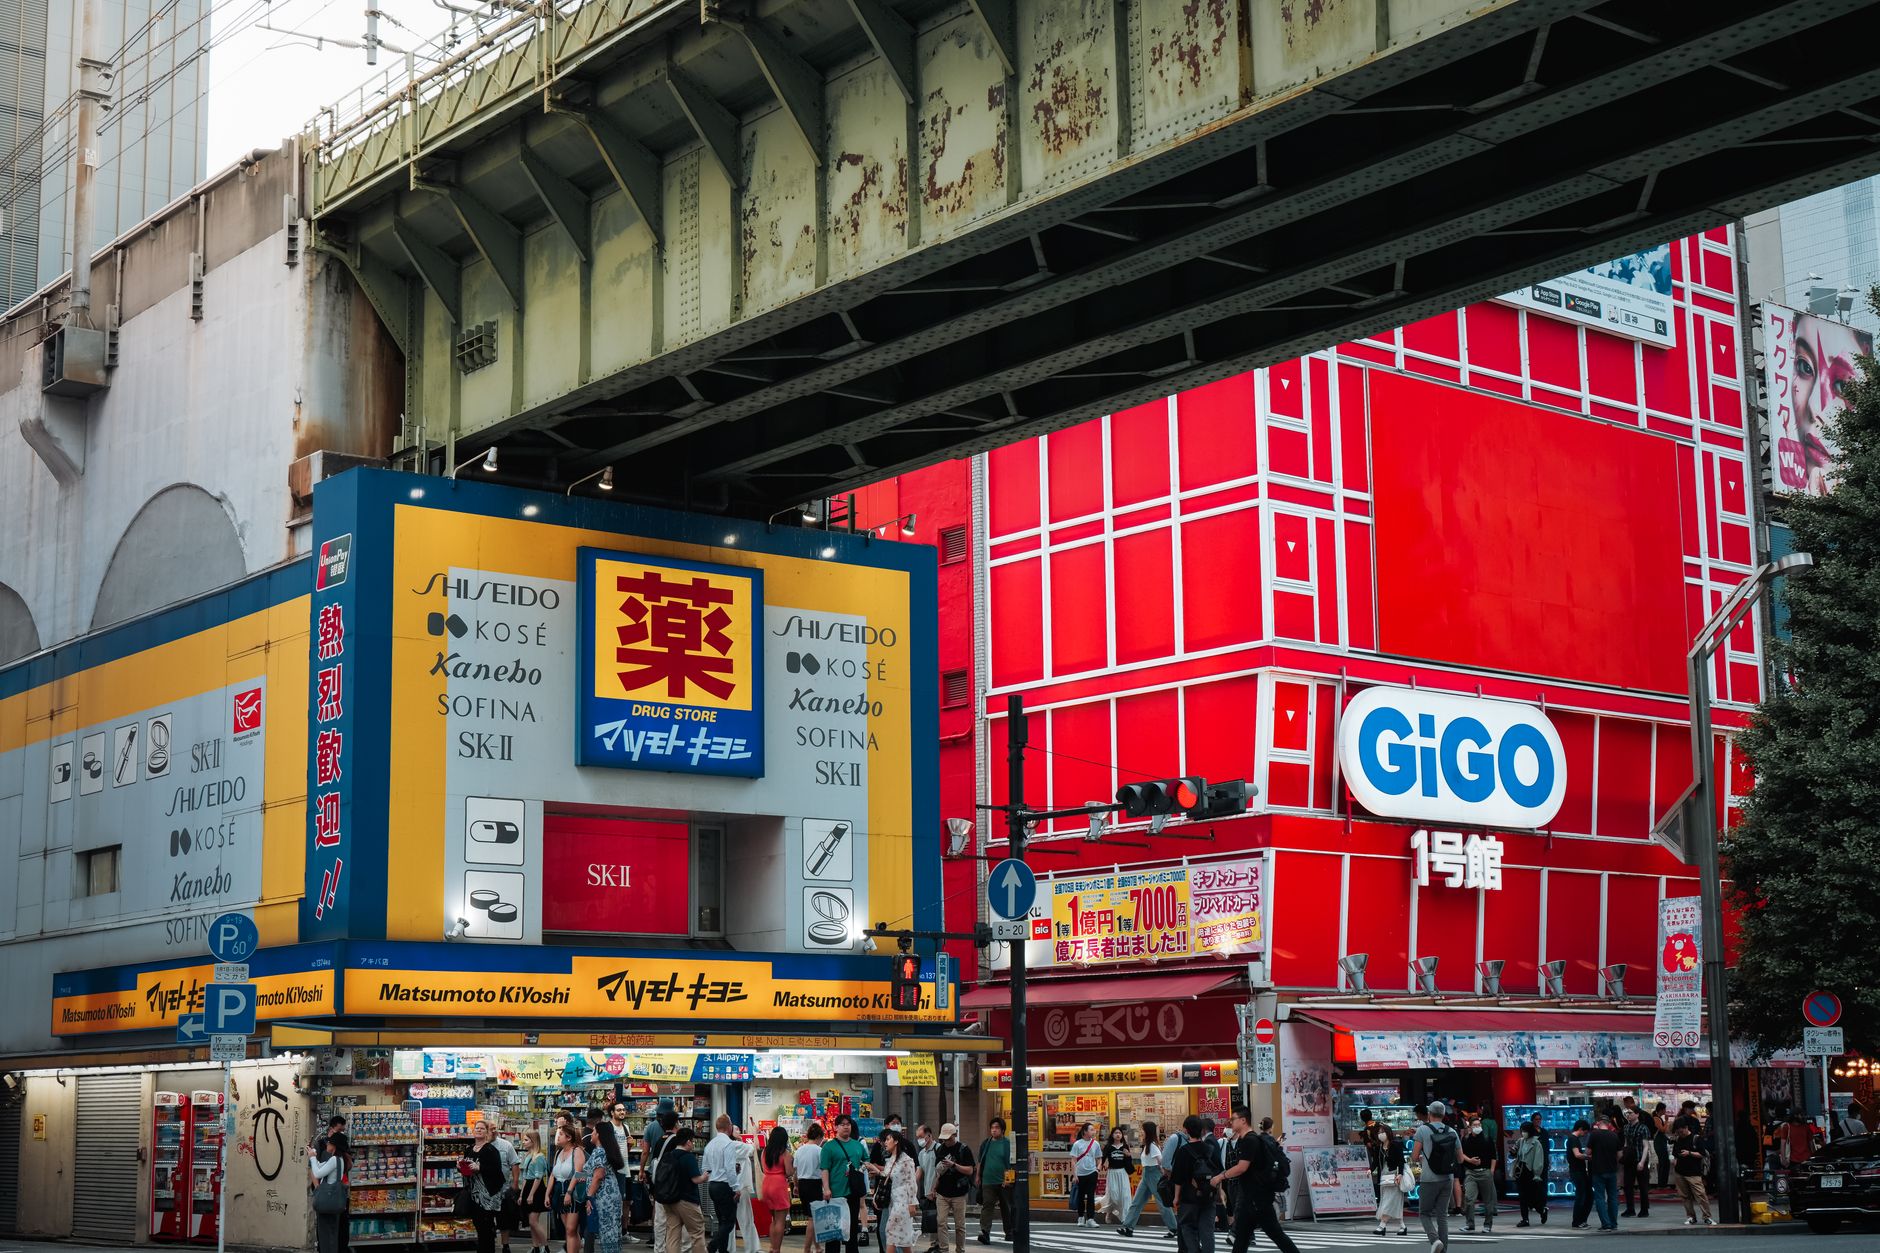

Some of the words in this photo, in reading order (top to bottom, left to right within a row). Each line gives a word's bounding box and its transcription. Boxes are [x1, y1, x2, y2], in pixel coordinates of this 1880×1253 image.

[320, 548, 348, 567] UnionPay
[412, 573, 560, 610] SHISEIDO
[476, 620, 547, 646] KOSÉ
[616, 571, 736, 700] 薬
[772, 616, 896, 648] SHISEIDO
[430, 652, 542, 686] Kanebo
[828, 659, 886, 680] KOSÉ
[437, 694, 536, 722] SOFINA
[632, 704, 670, 719] DRUG
[674, 708, 718, 723] STORE
[788, 688, 882, 718] Kanebo
[796, 726, 880, 752] SOFINA
[165, 776, 246, 816] SHISEIDO
[196, 816, 236, 852] KOSÉ
[1410, 830, 1504, 890] 1号館
[170, 864, 232, 902] Kanebo
[1193, 866, 1258, 888] ギフトカード
[166, 914, 217, 946] SOFIN
[220, 924, 238, 954] P
[232, 940, 246, 954] 60
[1056, 931, 1188, 962] 億万長者出ました!!
[285, 984, 322, 1004] KiYoshi
[379, 984, 496, 1002] Matsumoto
[500, 986, 570, 1004] KiYoshi
[773, 991, 868, 1009] Matsumoto
[62, 1008, 106, 1023] Matsumoto
[106, 1002, 136, 1018] KiYoshi
[218, 990, 246, 1028] P
[1074, 1006, 1150, 1044] 宝くじ
[500, 1068, 542, 1080] Welcome!
[544, 1065, 604, 1080] サマーセール
